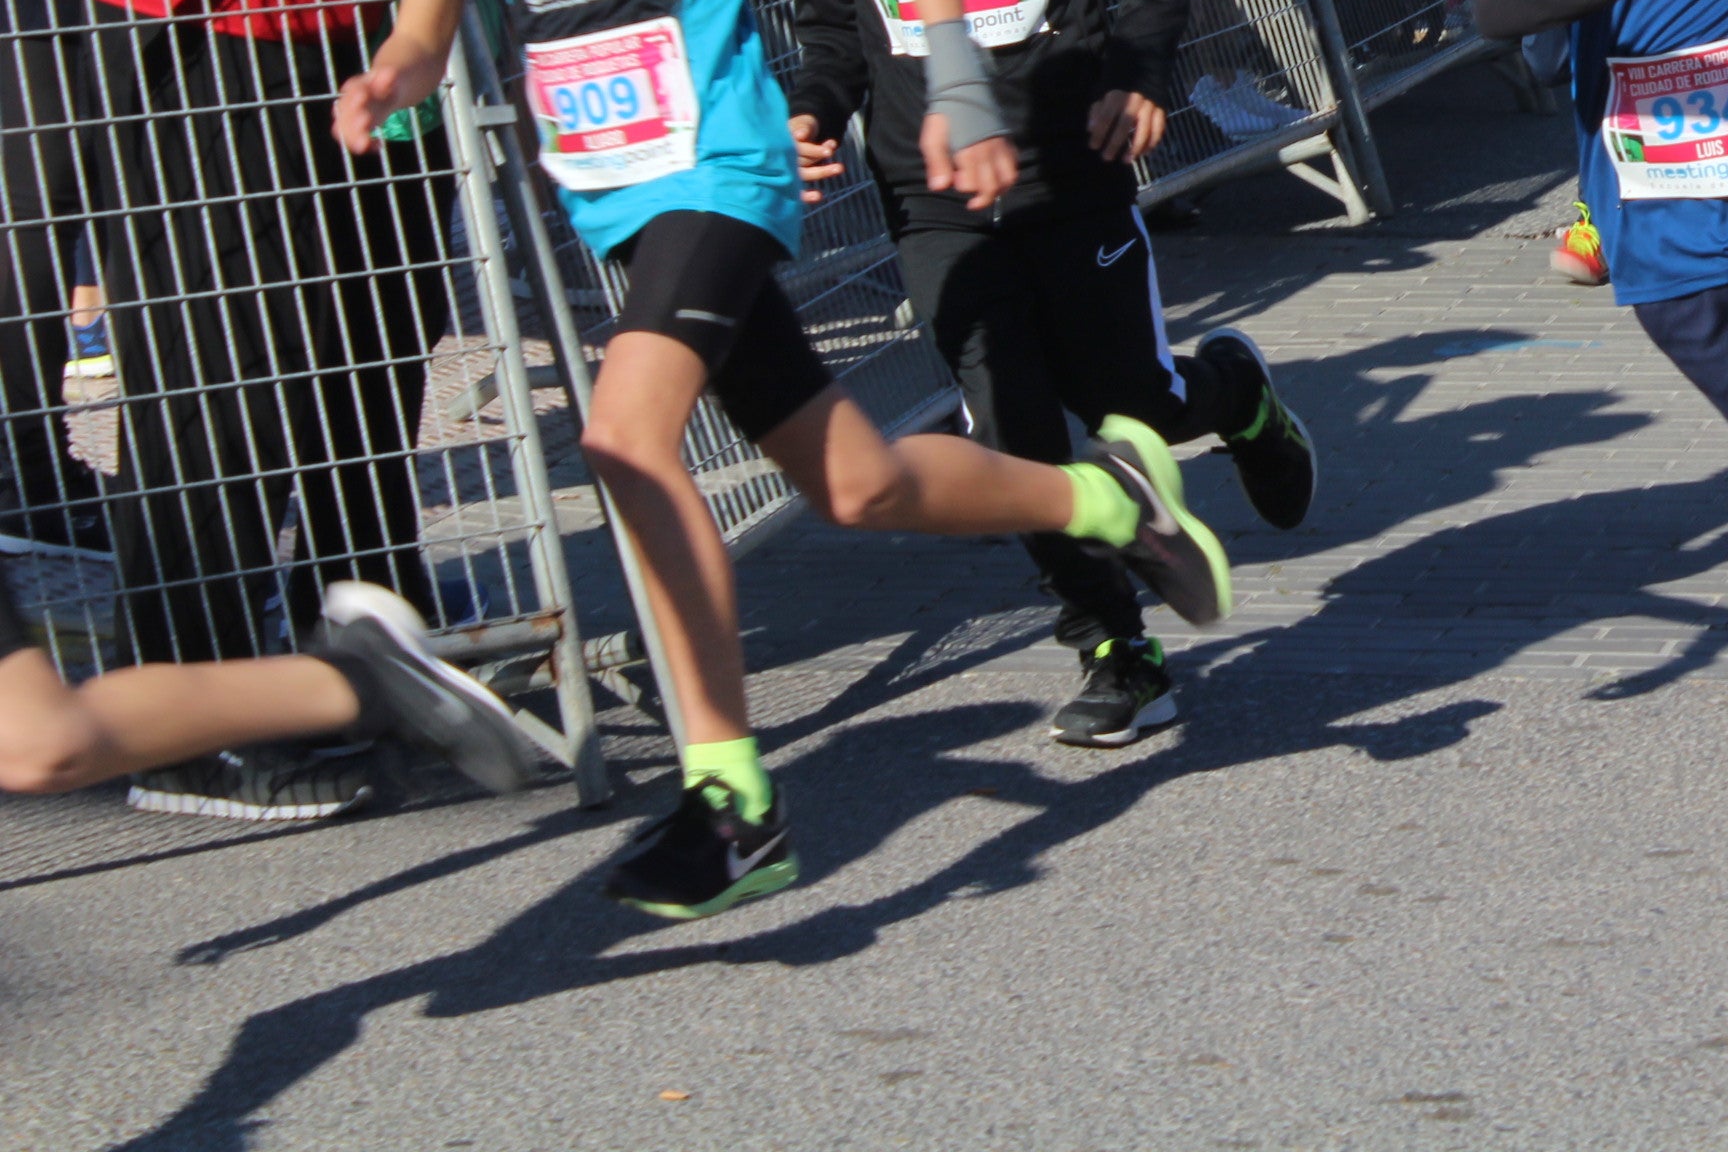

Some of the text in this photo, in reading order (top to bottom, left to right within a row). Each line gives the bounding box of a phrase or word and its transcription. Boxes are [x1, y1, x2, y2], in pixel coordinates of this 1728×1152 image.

[1627, 66, 1646, 81] VIII
[1647, 56, 1703, 78] CARRERA
[1629, 78, 1673, 97] CIUDAD
[1674, 75, 1692, 89] DE
[553, 76, 641, 131] 909
[1695, 139, 1725, 159] LUIS
